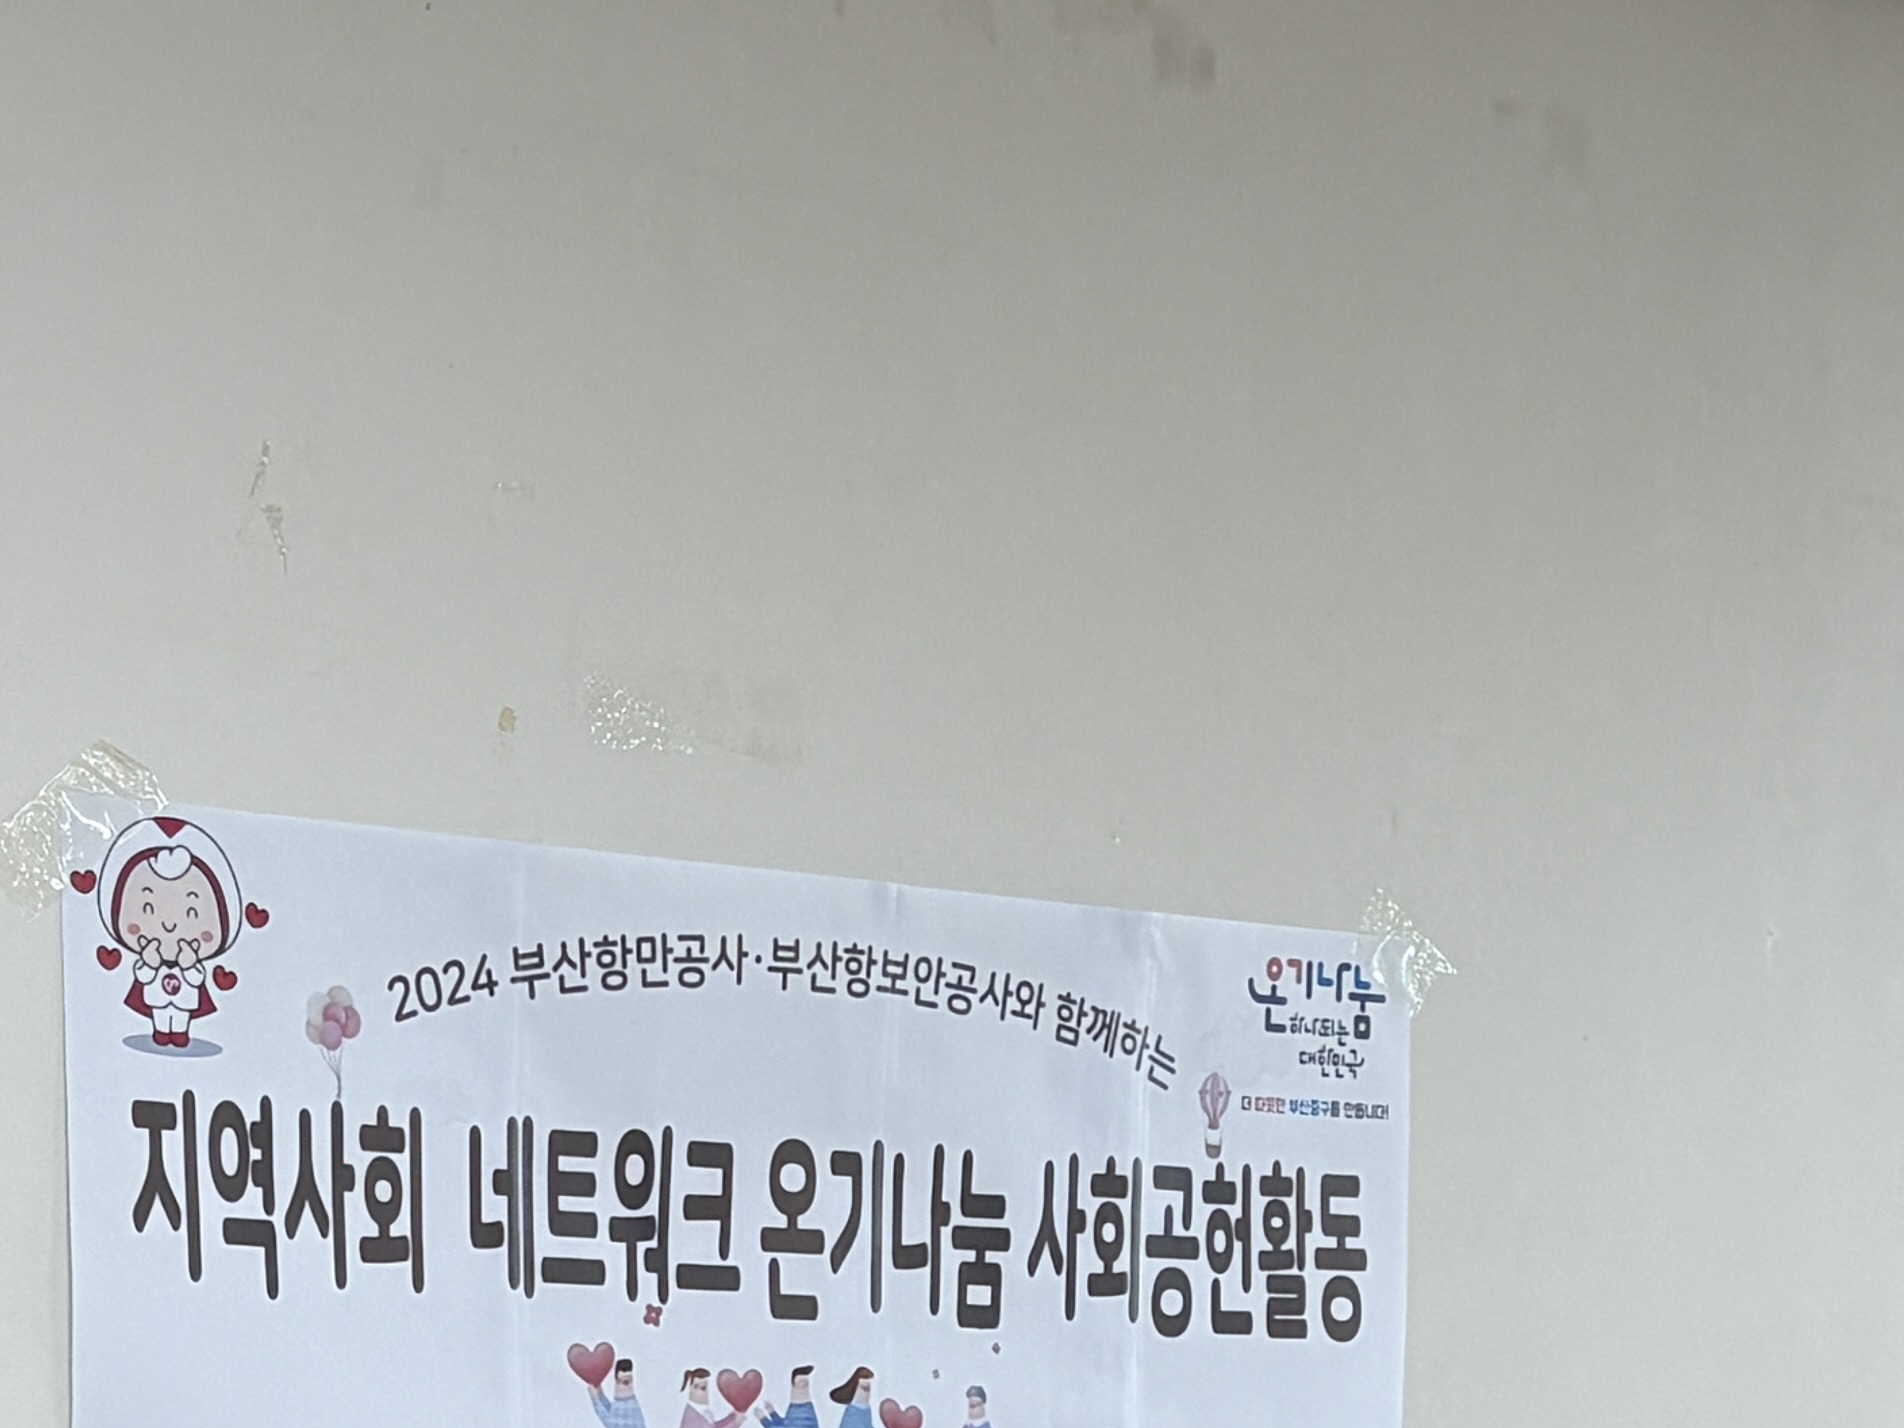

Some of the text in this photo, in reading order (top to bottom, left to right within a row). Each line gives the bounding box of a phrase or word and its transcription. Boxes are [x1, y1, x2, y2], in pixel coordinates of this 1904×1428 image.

[387, 933, 1179, 1093] 2024 부산항만공사·부산항보안공사와 함께하는
[1248, 956, 1387, 1040] 온기나눔
[1289, 1012, 1350, 1046] 하나되는
[1299, 1044, 1365, 1079] 대한민국
[129, 1088, 1370, 1343] 지역사회 네트워크 온기나눔 사회공헌활동
